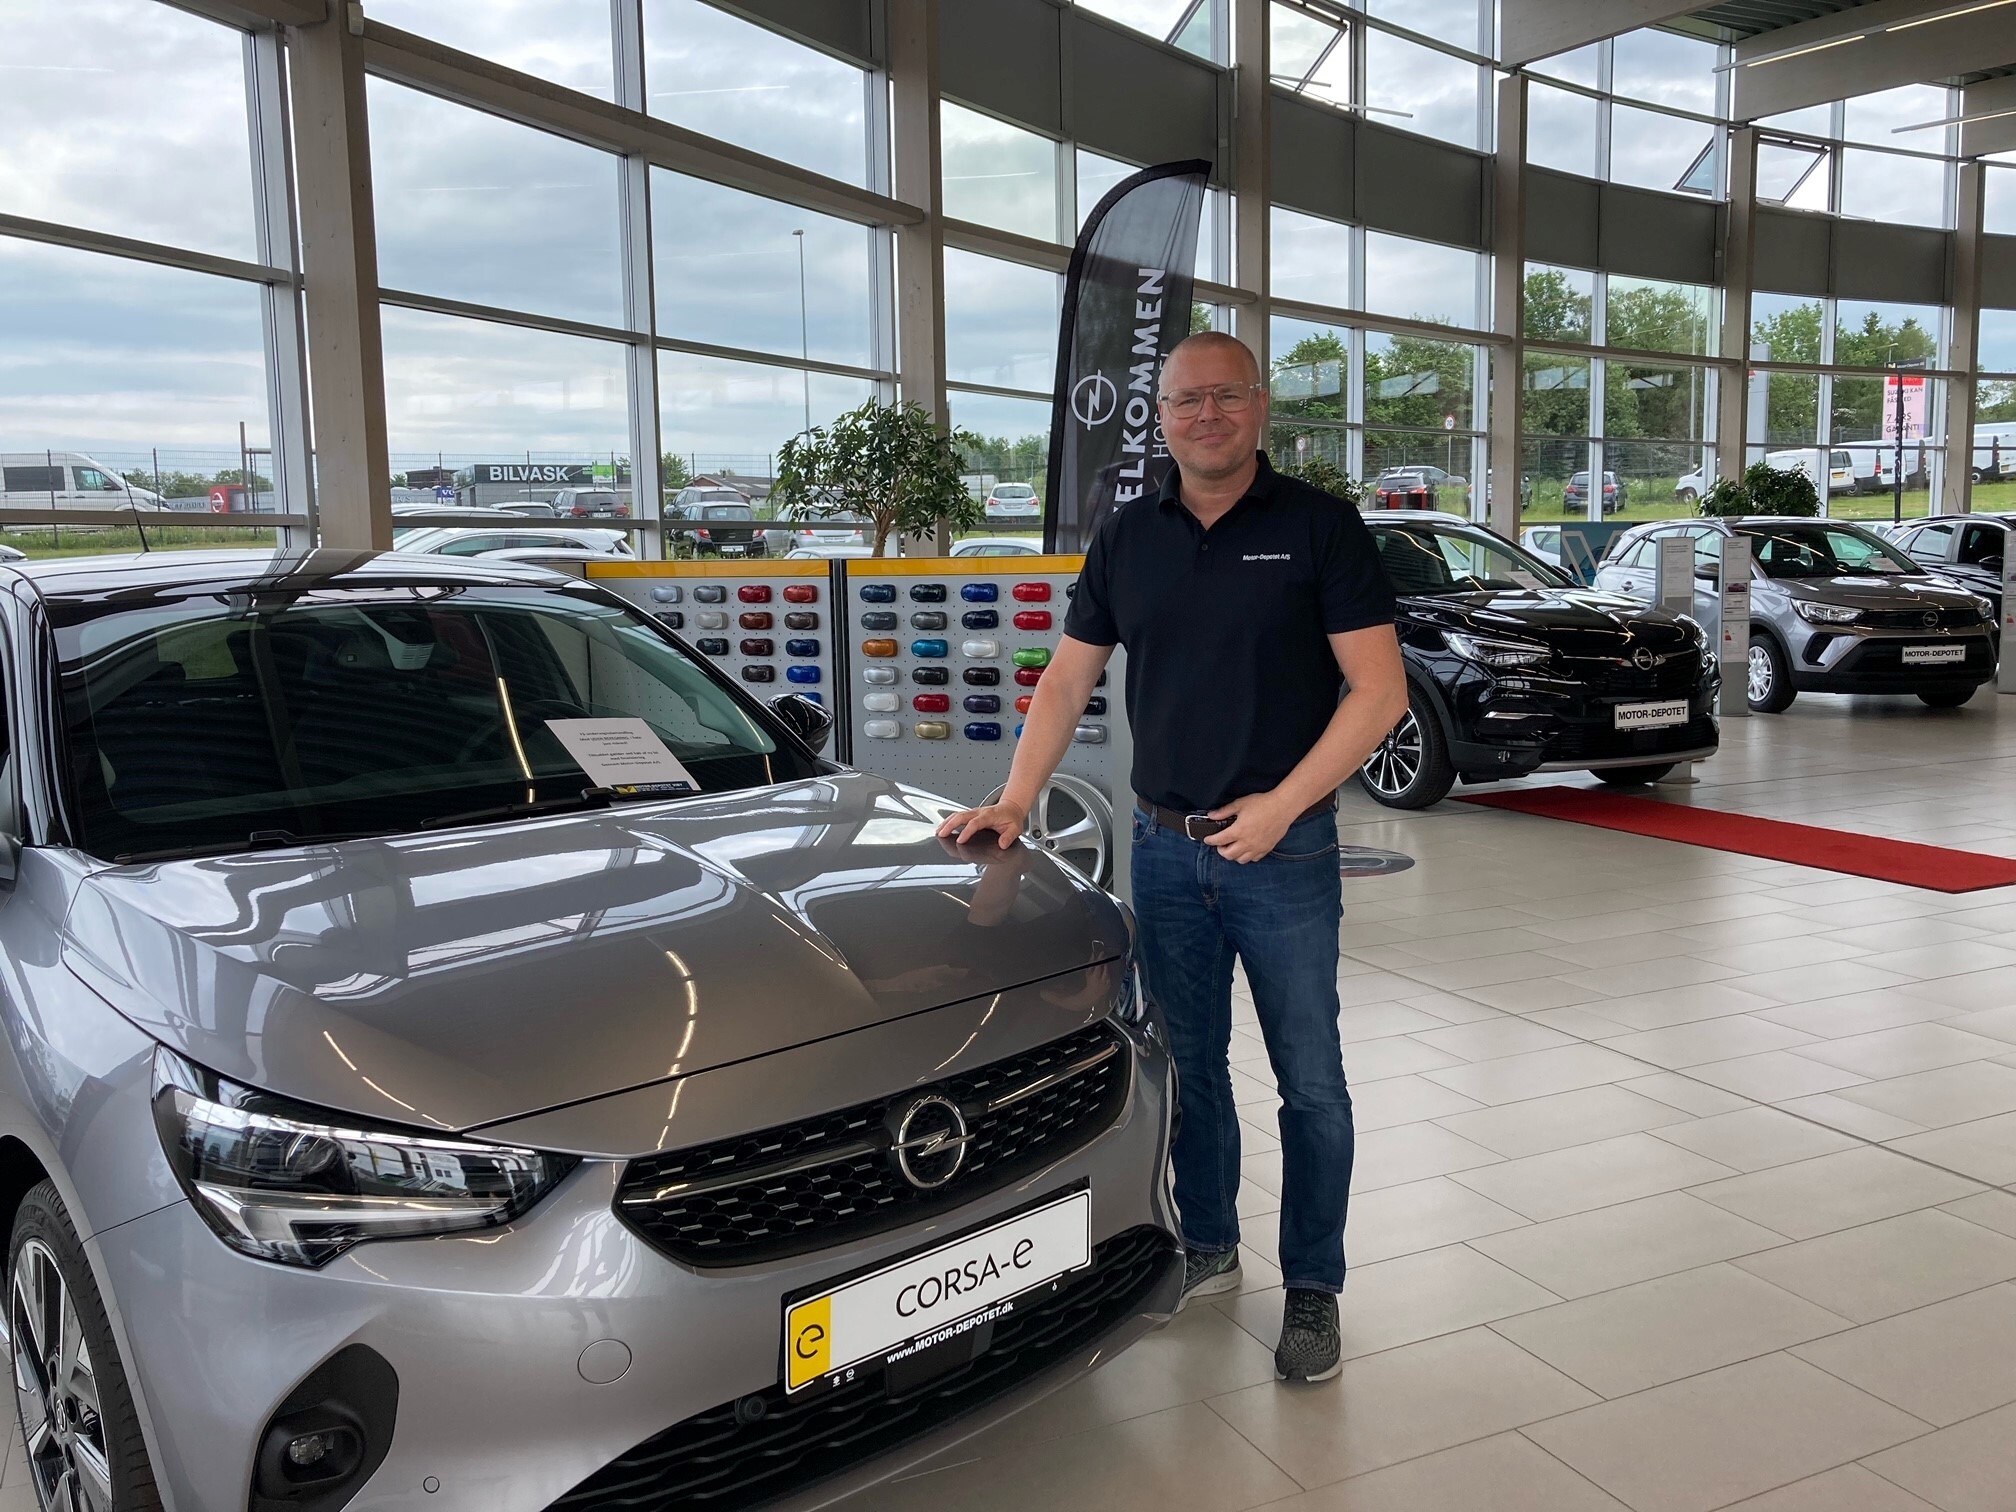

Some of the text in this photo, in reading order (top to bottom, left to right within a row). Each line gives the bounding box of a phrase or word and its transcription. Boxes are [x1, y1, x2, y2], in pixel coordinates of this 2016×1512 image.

[1113, 268, 1166, 513] ELKOMMEN
[1885, 424, 1920, 433] GAANTI
[490, 466, 569, 481] BILVASK
[1904, 649, 1964, 658] MOTOR-DEPOTET
[1618, 706, 1687, 721] MOTOR-DEPOTET
[896, 1238, 1034, 1317] CORSA-e
[886, 1302, 1014, 1364] www.MOTOR-DEPOTET.dk
